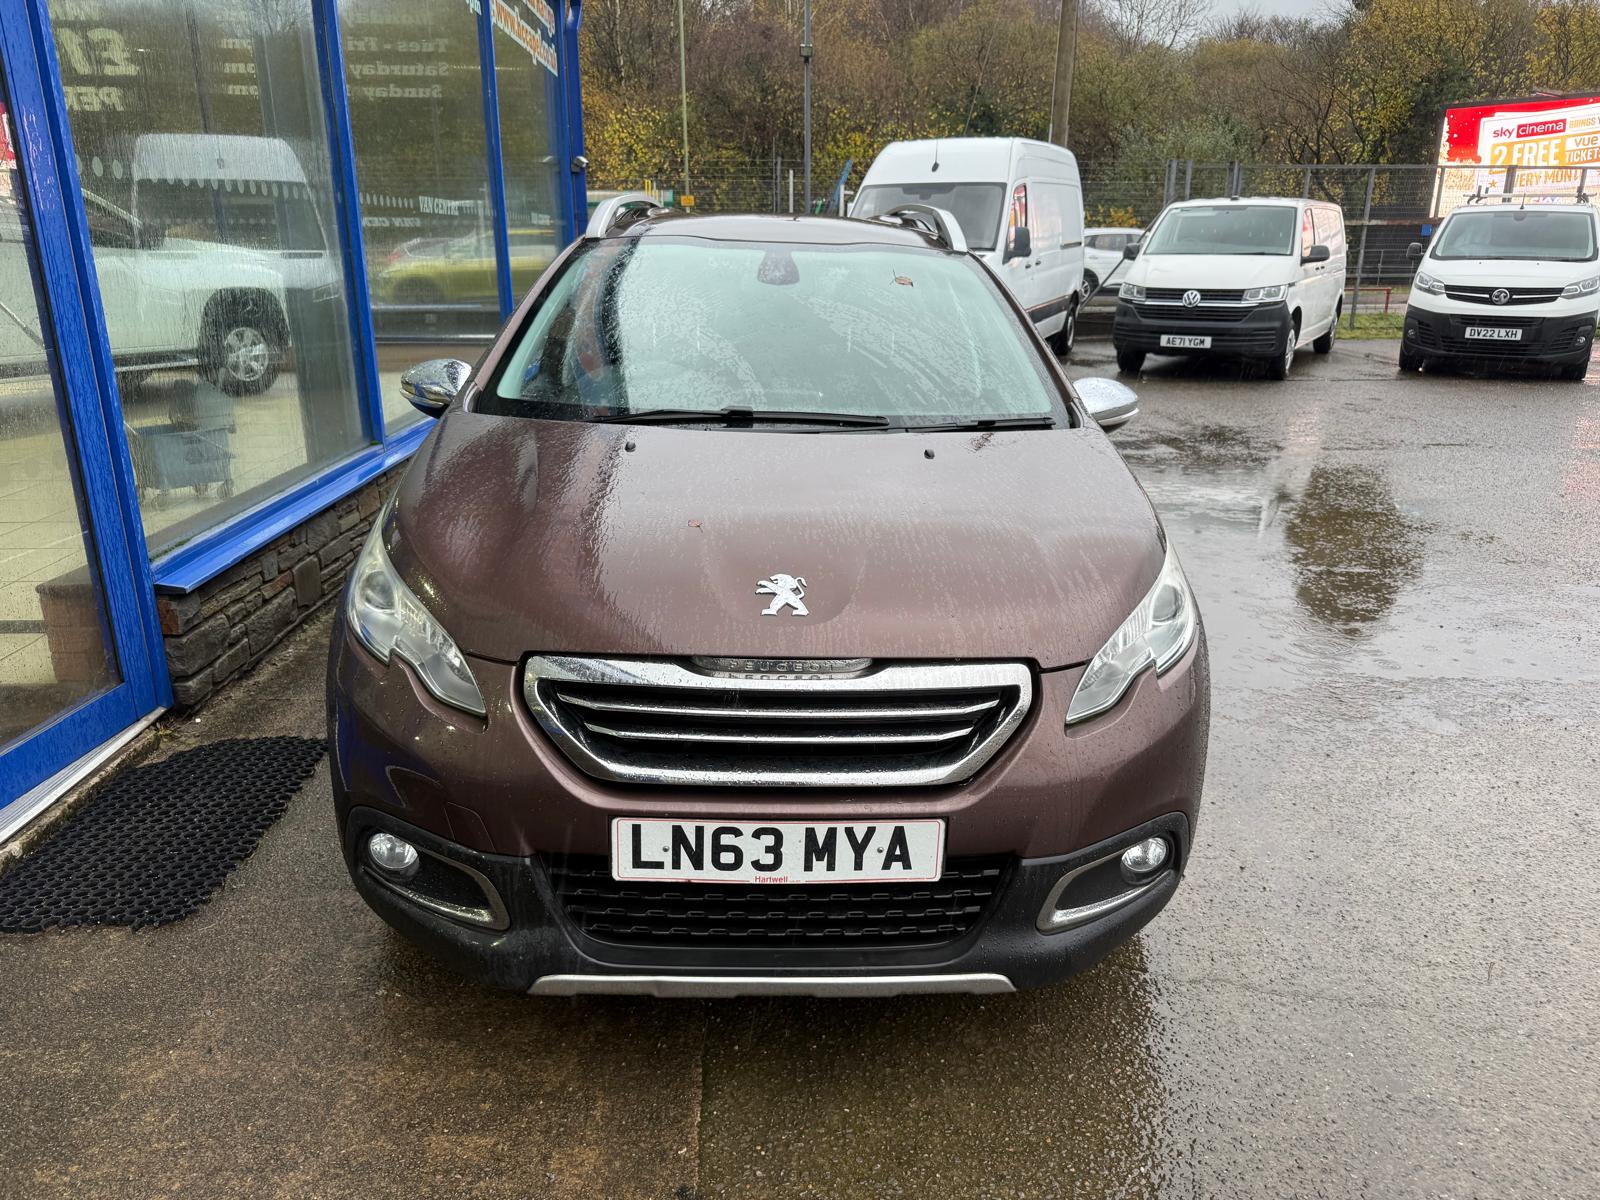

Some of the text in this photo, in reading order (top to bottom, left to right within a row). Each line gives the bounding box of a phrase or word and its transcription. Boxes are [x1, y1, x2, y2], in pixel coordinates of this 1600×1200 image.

[1493, 127, 1515, 138] sky
[1519, 121, 1564, 136] cinema
[1569, 117, 1596, 129] BRINGS
[1575, 136, 1599, 148] vue
[1493, 139, 1561, 166] 2 FREE
[418, 195, 433, 214] VAN
[1166, 336, 1206, 347] AE71 YGM
[1469, 328, 1518, 339] DV22 LXH
[631, 823, 913, 872] LN63 MYA
